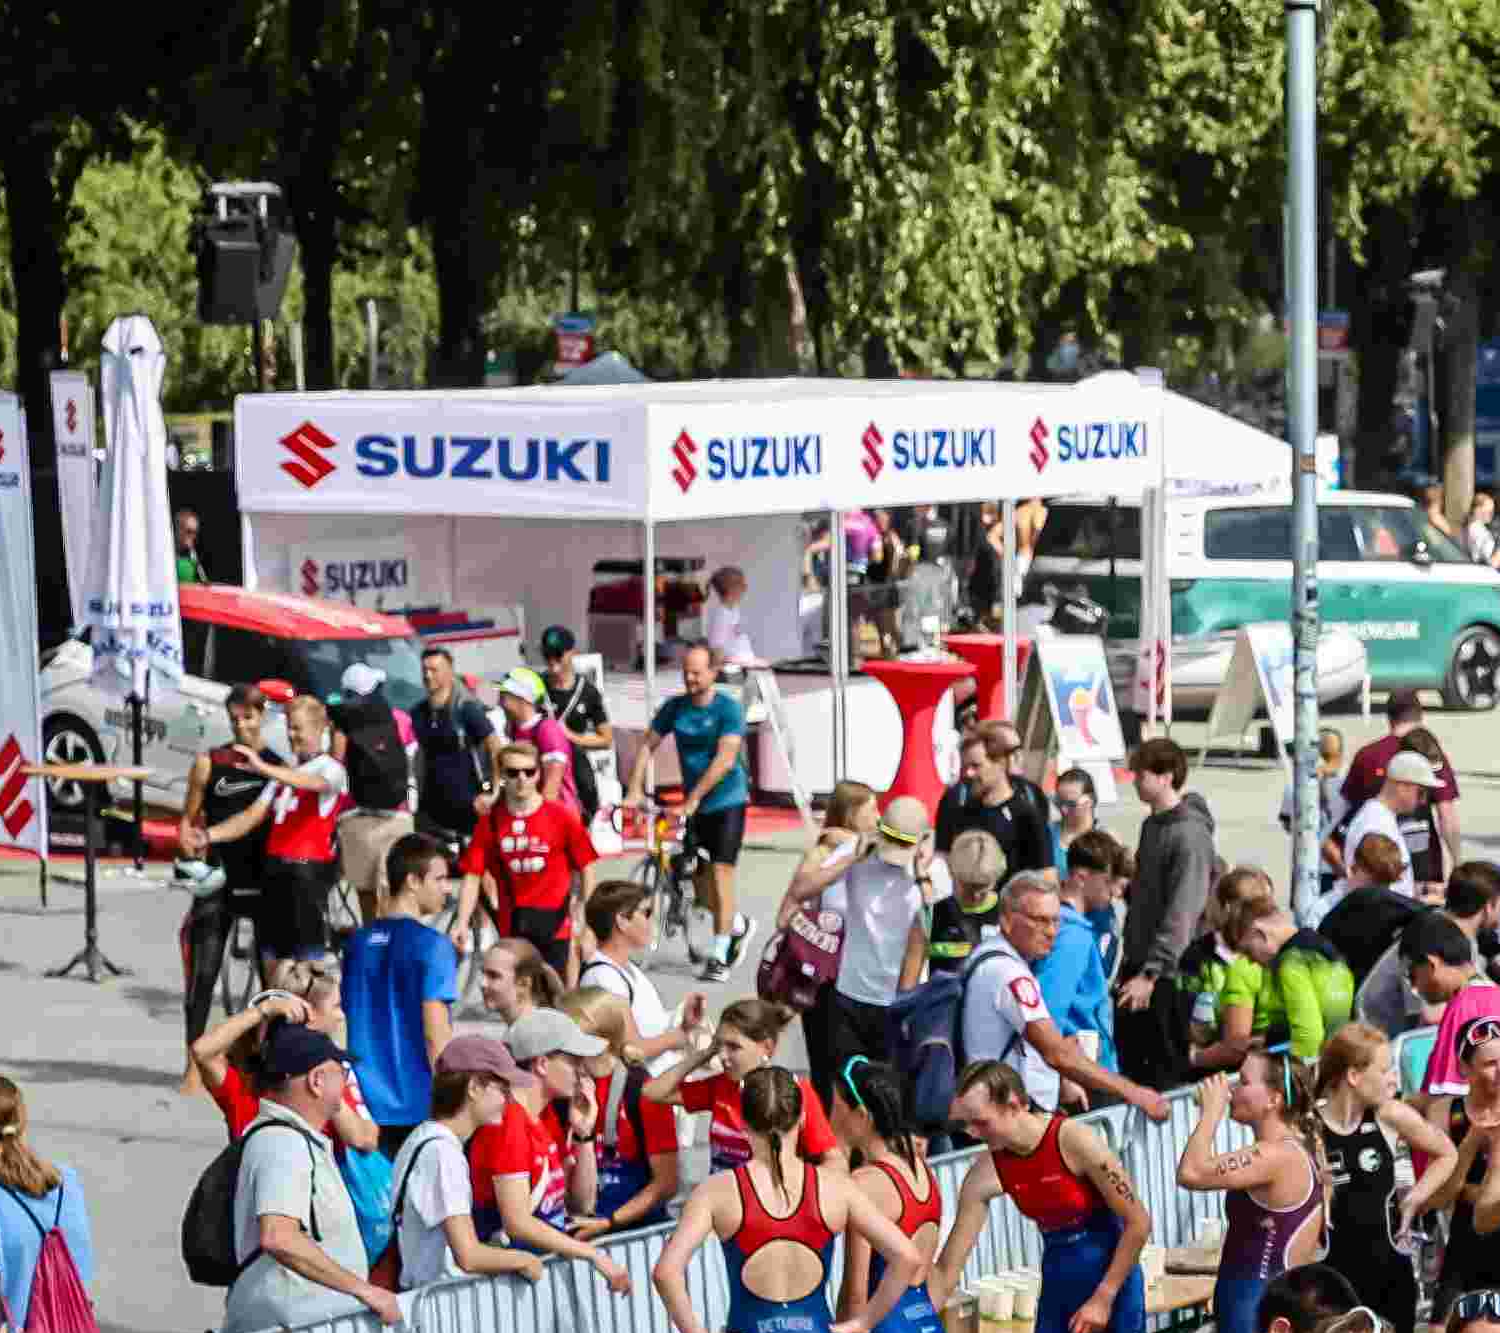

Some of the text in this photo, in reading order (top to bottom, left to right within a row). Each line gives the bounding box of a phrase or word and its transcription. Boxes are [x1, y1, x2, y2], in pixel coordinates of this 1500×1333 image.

[354, 434, 612, 483] SUZUKI
[706, 434, 823, 479] SUZUKI
[891, 428, 998, 471] SUZUKI
[1056, 421, 1150, 464] SUZUKI
[325, 560, 407, 593] SUZUKI
